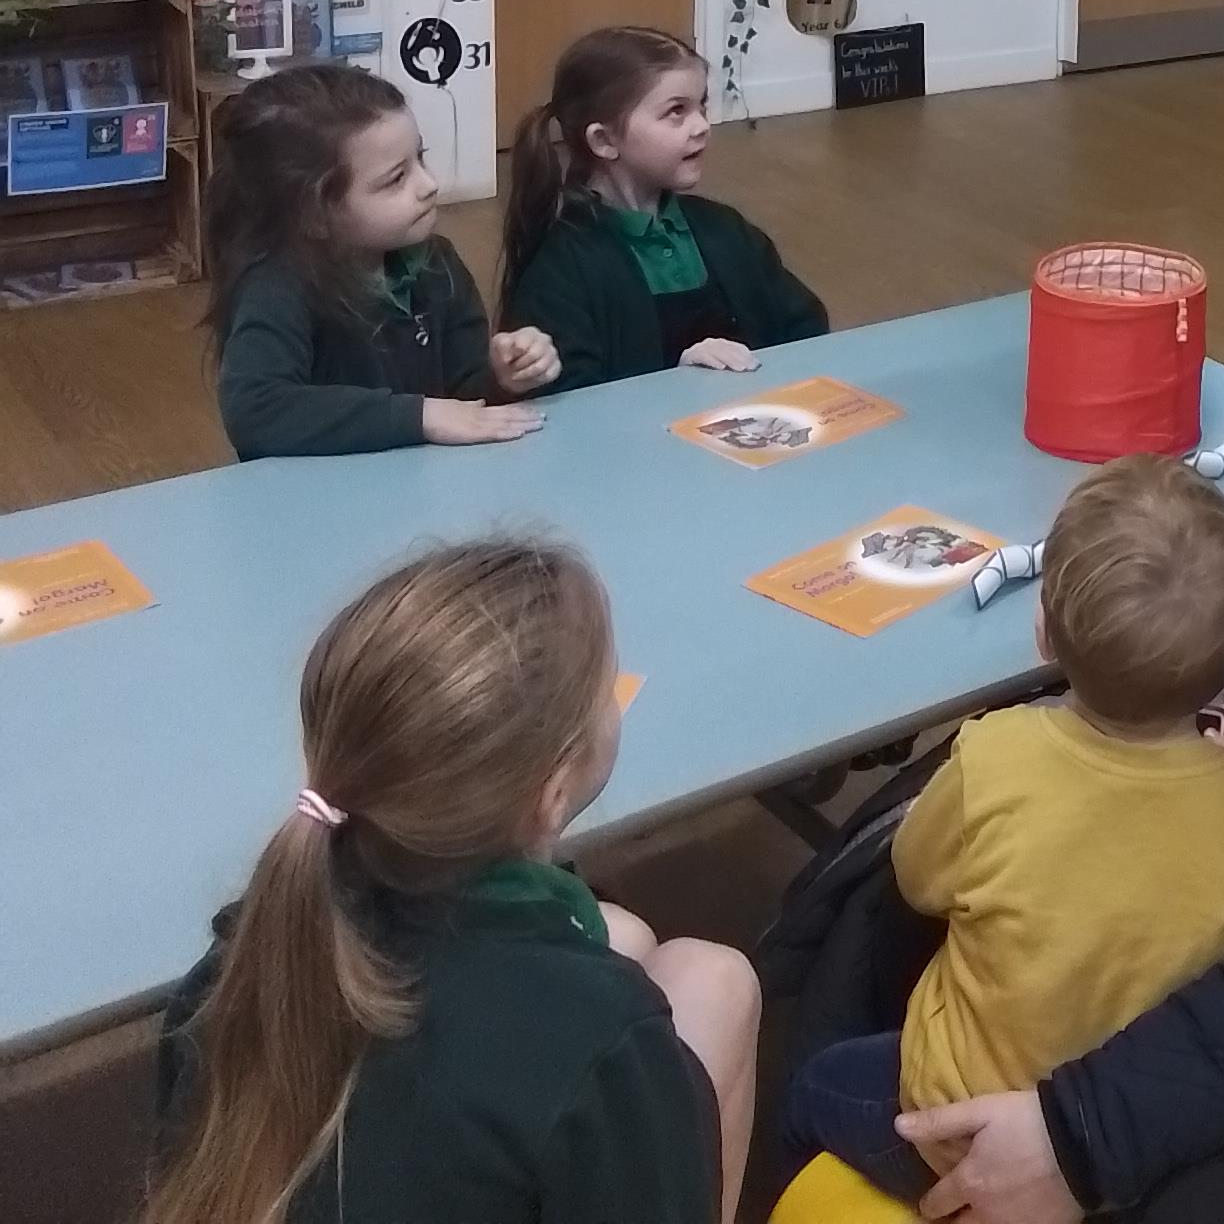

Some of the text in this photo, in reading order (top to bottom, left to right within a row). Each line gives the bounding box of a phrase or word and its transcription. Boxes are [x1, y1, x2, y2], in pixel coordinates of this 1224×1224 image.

[801, 22, 829, 33] Year
[463, 41, 491, 70] 31
[840, 39, 909, 59] Congratulations
[55, 588, 115, 608] Come
